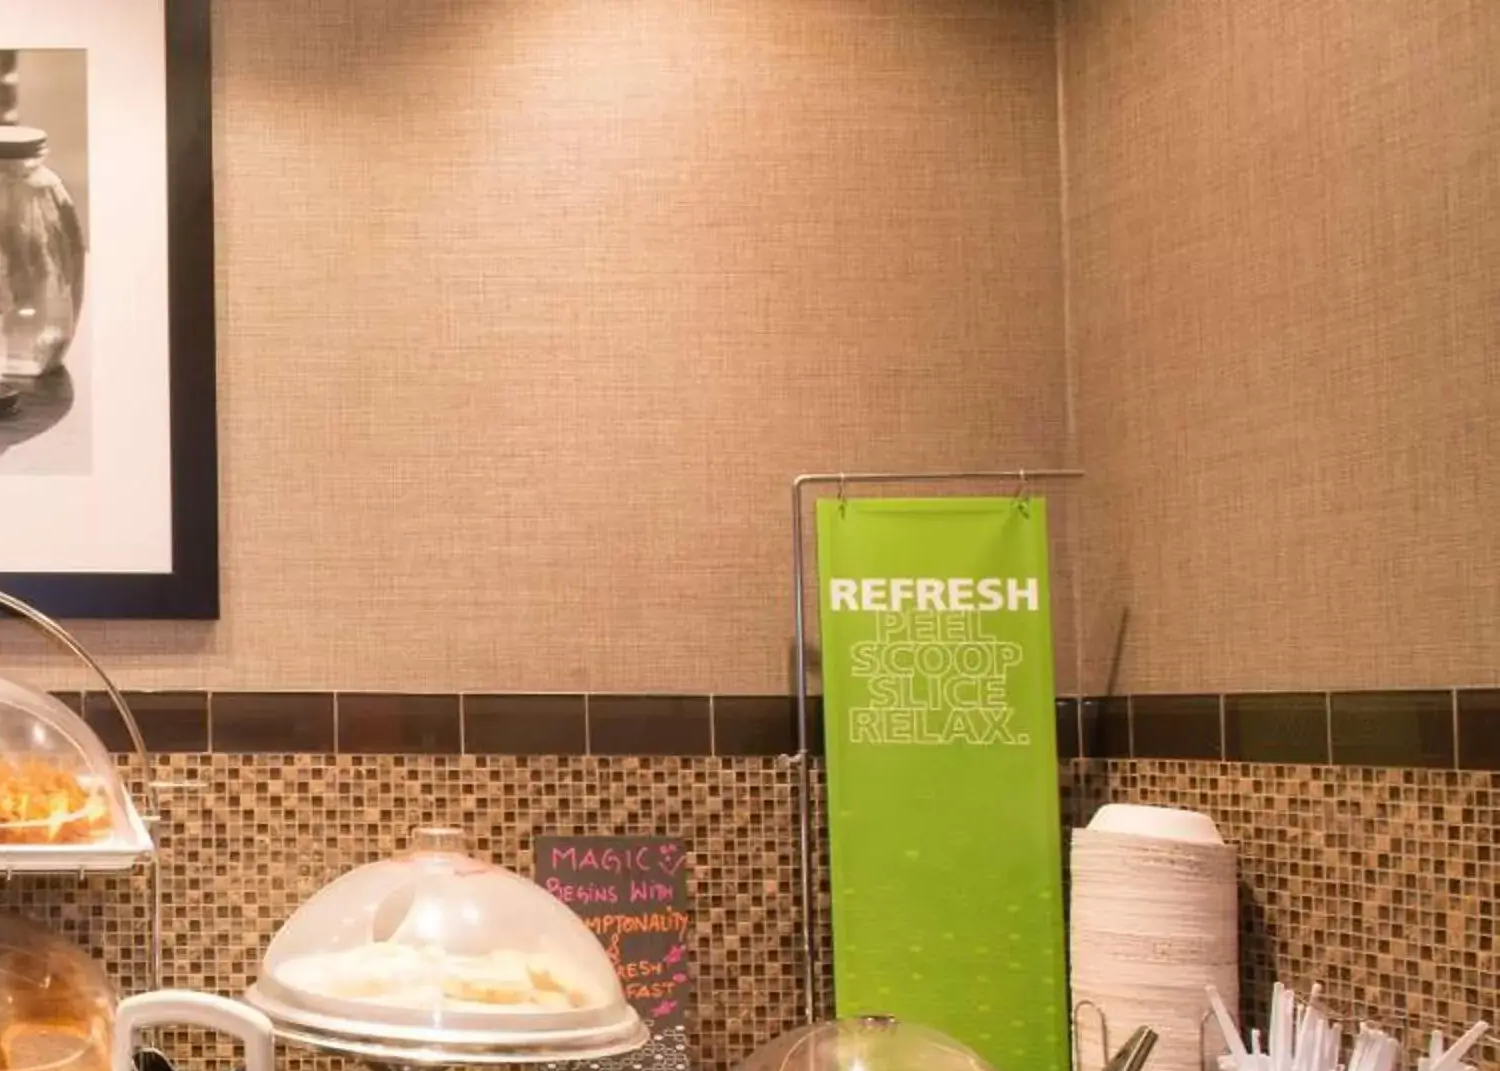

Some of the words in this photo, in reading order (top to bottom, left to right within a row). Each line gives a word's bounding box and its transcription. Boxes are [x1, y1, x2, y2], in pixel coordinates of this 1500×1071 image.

[829, 577, 1040, 612] REFRESH
[875, 610, 997, 644] PEEL
[851, 640, 1024, 678] SCOOP
[867, 675, 1008, 711] SLICE
[848, 706, 1033, 746] RELAX.
[551, 847, 651, 874] MAGIC
